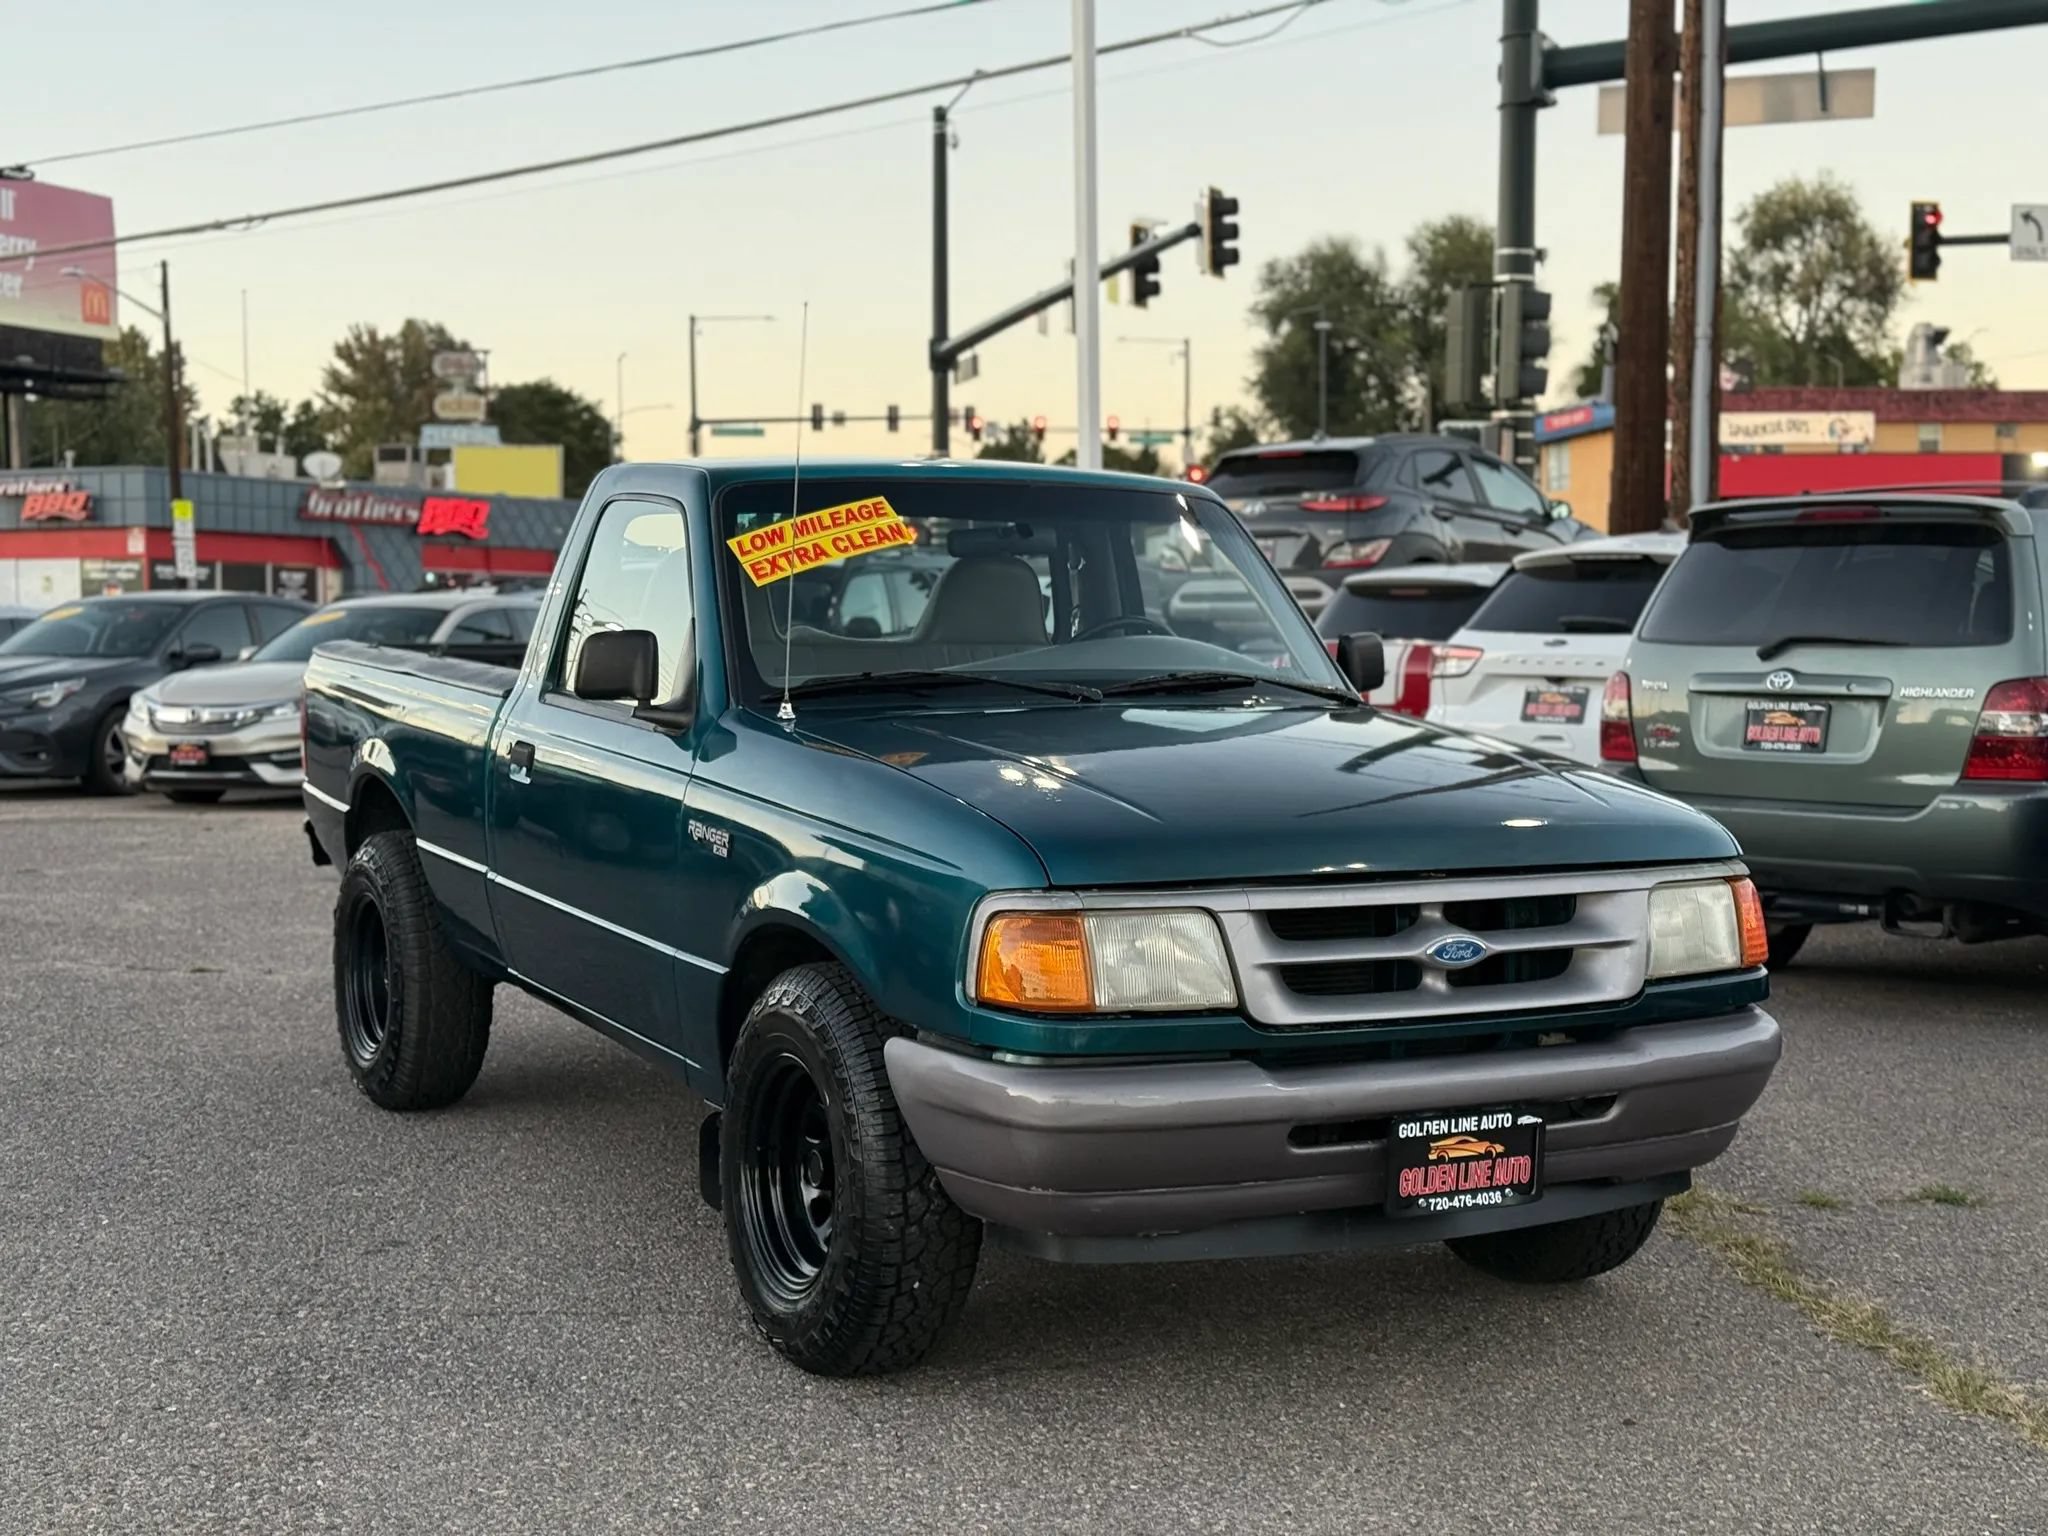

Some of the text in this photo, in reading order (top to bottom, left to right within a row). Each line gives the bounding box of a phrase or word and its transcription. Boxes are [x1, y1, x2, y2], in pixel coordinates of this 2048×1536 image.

[736, 501, 888, 557] LOW MILEAGE
[749, 522, 907, 580] EXTRA CLEAN
[1900, 686, 1976, 698] HIGHLANDER
[1443, 943, 1473, 959] Ford
[1399, 1113, 1513, 1138] GOLDEN LINE AUTO
[1399, 1155, 1532, 1197] GOLDEN LINE AUTO
[1429, 1191, 1503, 1211] 720-476-4036
